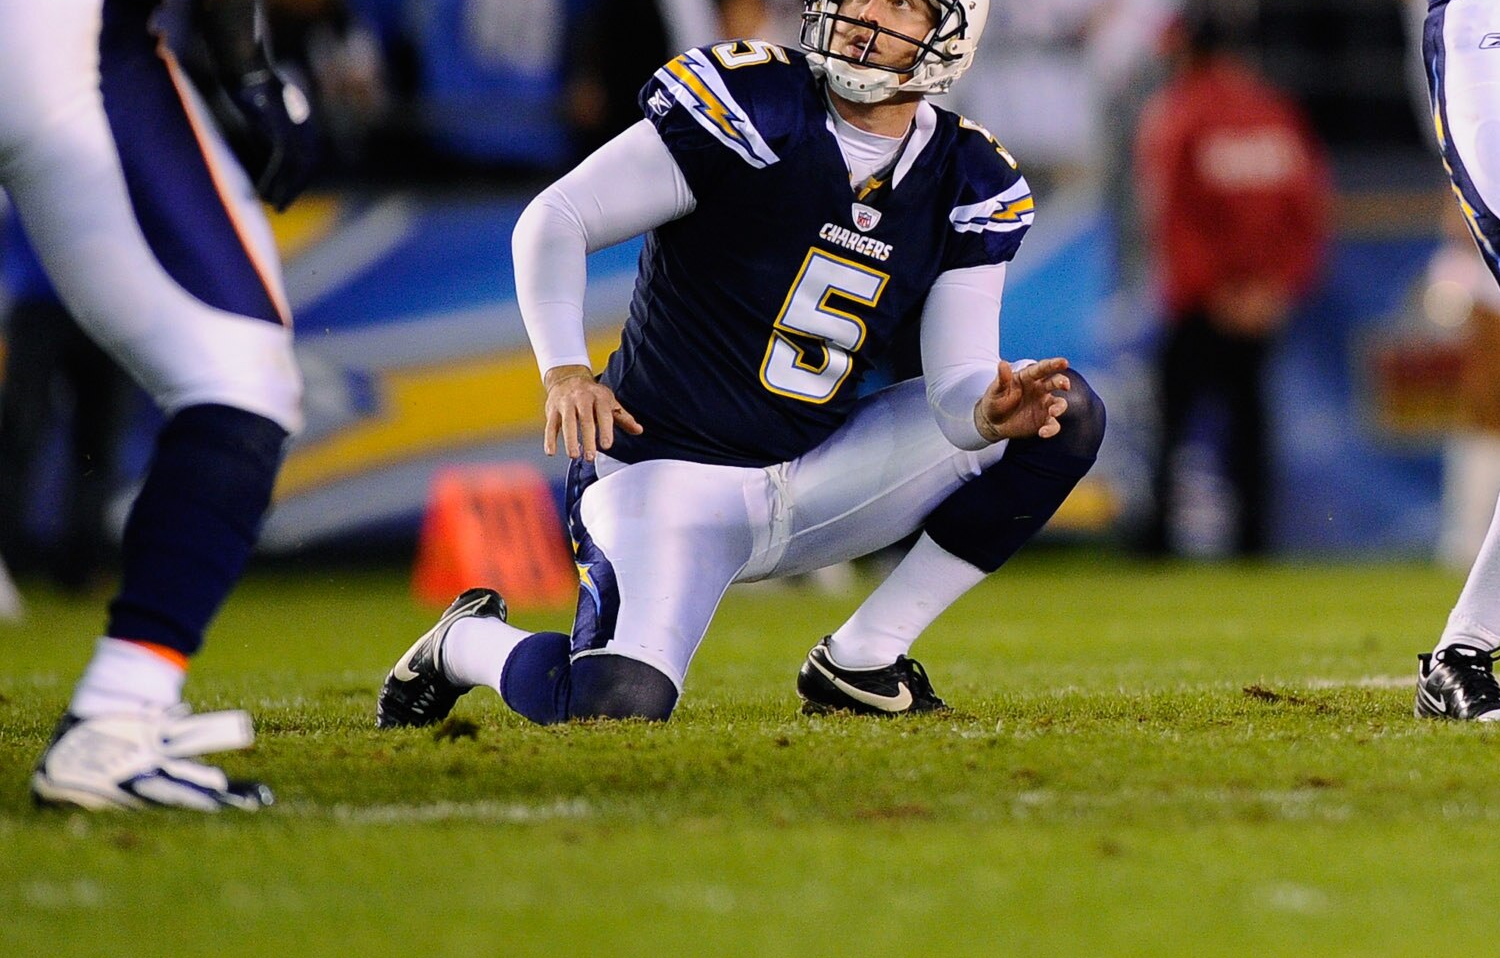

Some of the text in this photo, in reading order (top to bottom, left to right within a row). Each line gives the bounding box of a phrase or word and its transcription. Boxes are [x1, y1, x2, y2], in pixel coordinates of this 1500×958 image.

[711, 39, 791, 70] 5
[818, 222, 894, 262] CHARGERS
[759, 246, 891, 404] 5
